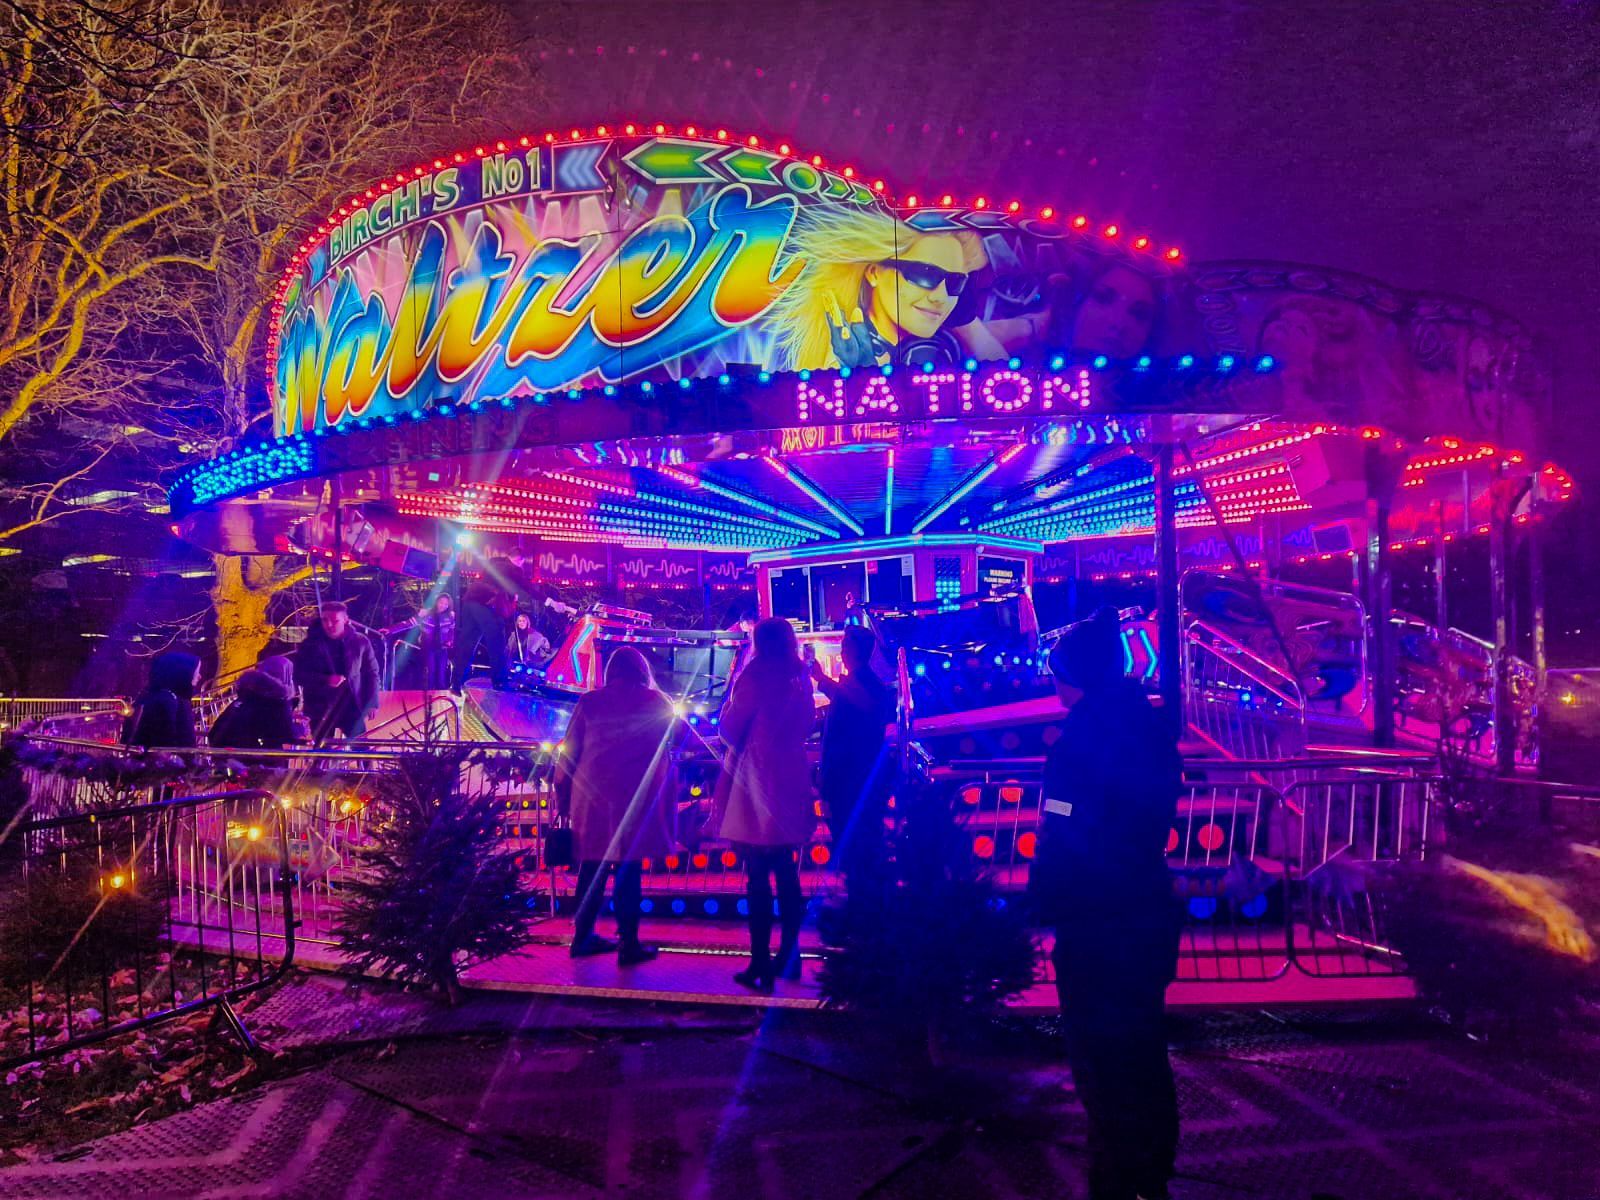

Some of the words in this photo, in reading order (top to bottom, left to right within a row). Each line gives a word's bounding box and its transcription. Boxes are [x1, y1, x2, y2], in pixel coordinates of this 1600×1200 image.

[329, 168, 460, 265] BIRCH'S
[280, 184, 806, 437] Waltzer
[797, 368, 1093, 420] NATION
